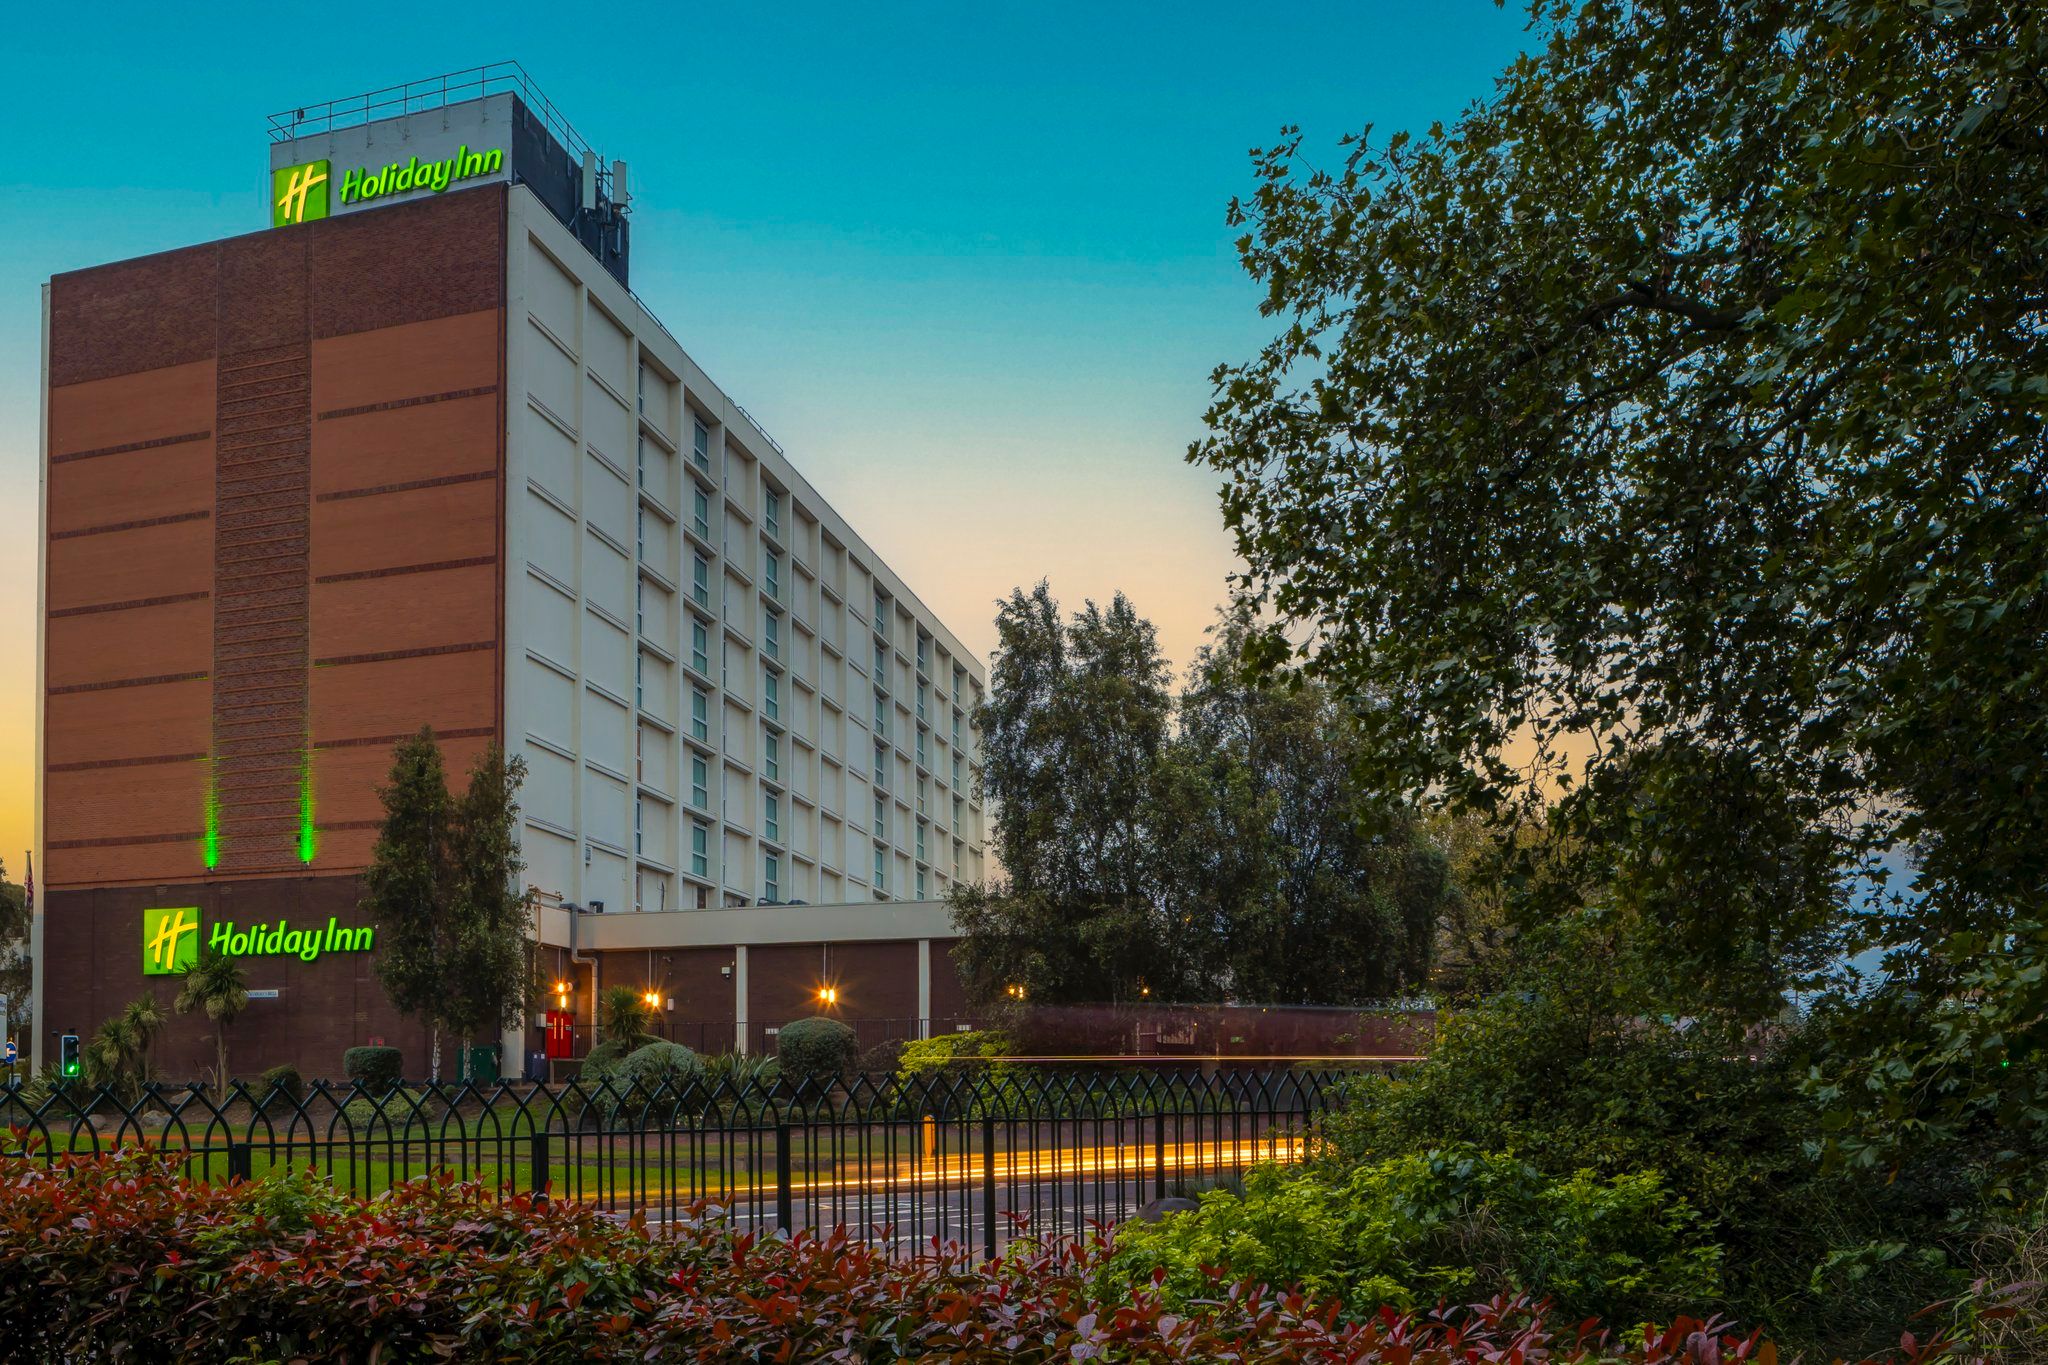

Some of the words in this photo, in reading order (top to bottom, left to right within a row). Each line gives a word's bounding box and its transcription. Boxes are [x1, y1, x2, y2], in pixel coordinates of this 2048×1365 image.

[339, 156, 453, 204] Holiday
[454, 144, 503, 179] Inn
[208, 919, 322, 961] Holiday
[324, 917, 374, 952] Inn
